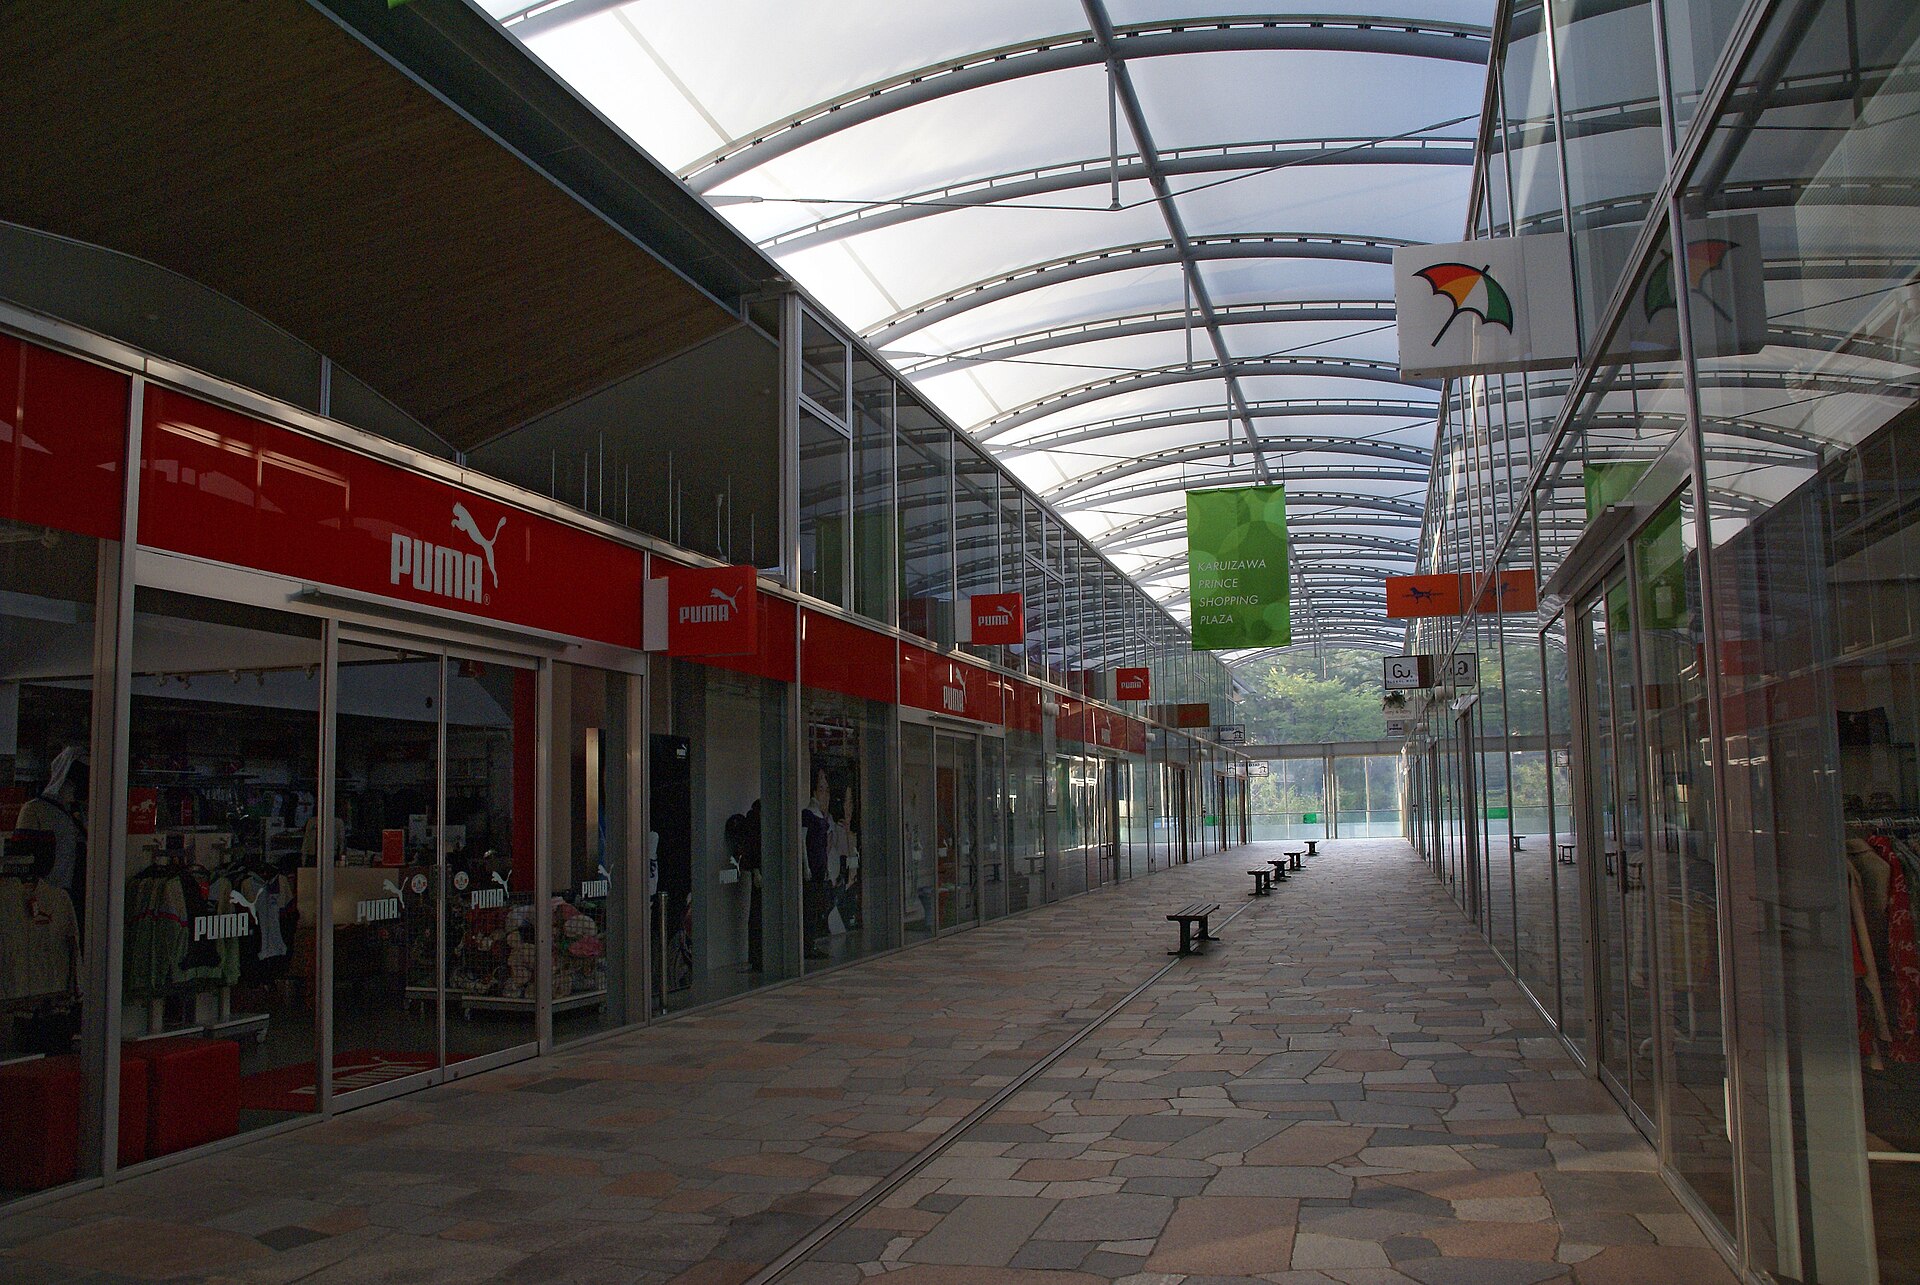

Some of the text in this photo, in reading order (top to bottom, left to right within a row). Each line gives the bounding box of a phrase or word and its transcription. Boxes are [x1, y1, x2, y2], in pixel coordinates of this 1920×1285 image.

[391, 532, 483, 604] PUMA
[1198, 559, 1267, 572] KARUIZAWA
[1198, 578, 1239, 589] PRINCE
[1199, 595, 1259, 608] SHOPPING
[679, 604, 729, 624] PUMA
[977, 615, 1009, 627] PUMA
[1200, 614, 1234, 625] PLAZA
[471, 888, 504, 909] PUMA
[582, 880, 608, 899] PUMA
[357, 898, 398, 922] PUMA
[194, 912, 249, 941] PUMA
